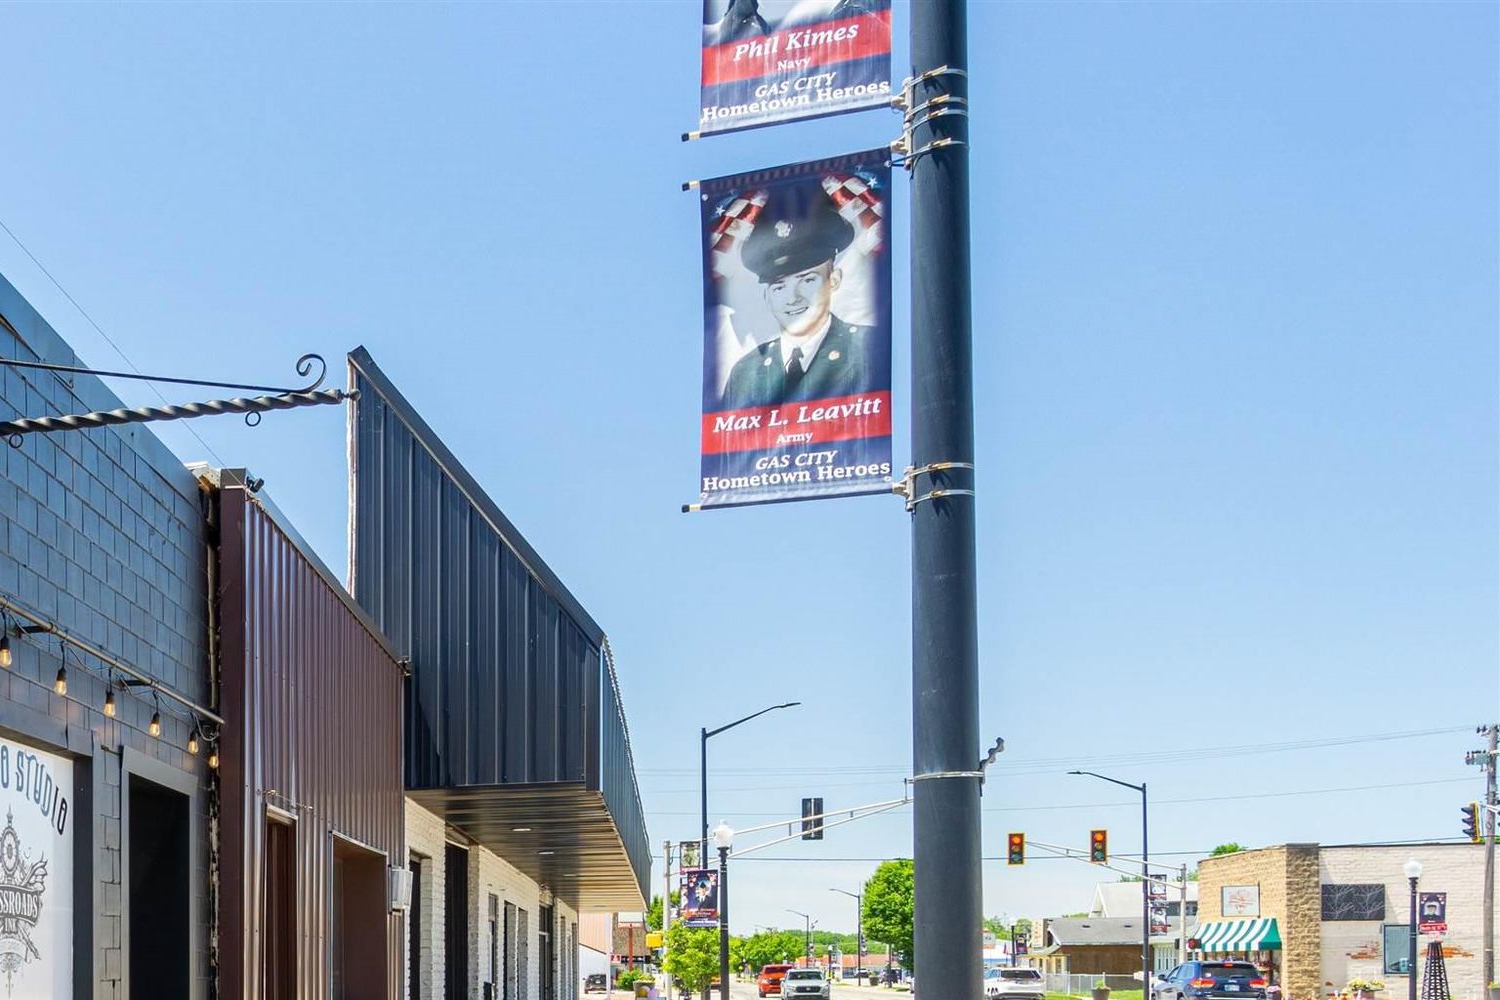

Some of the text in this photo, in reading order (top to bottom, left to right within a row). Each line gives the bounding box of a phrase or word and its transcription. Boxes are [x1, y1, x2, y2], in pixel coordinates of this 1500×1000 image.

[733, 23, 859, 61] Phil Kimes
[777, 57, 811, 71] Navy
[755, 72, 836, 98] GAS CITY
[702, 80, 890, 122] Hometown Heroes
[713, 398, 882, 433] Max L. Leavitt
[776, 432, 813, 444] Army
[756, 450, 837, 470] GAS CITY
[703, 462, 890, 490] Hometown Heroes
[15, 749, 69, 836] STUDIO
